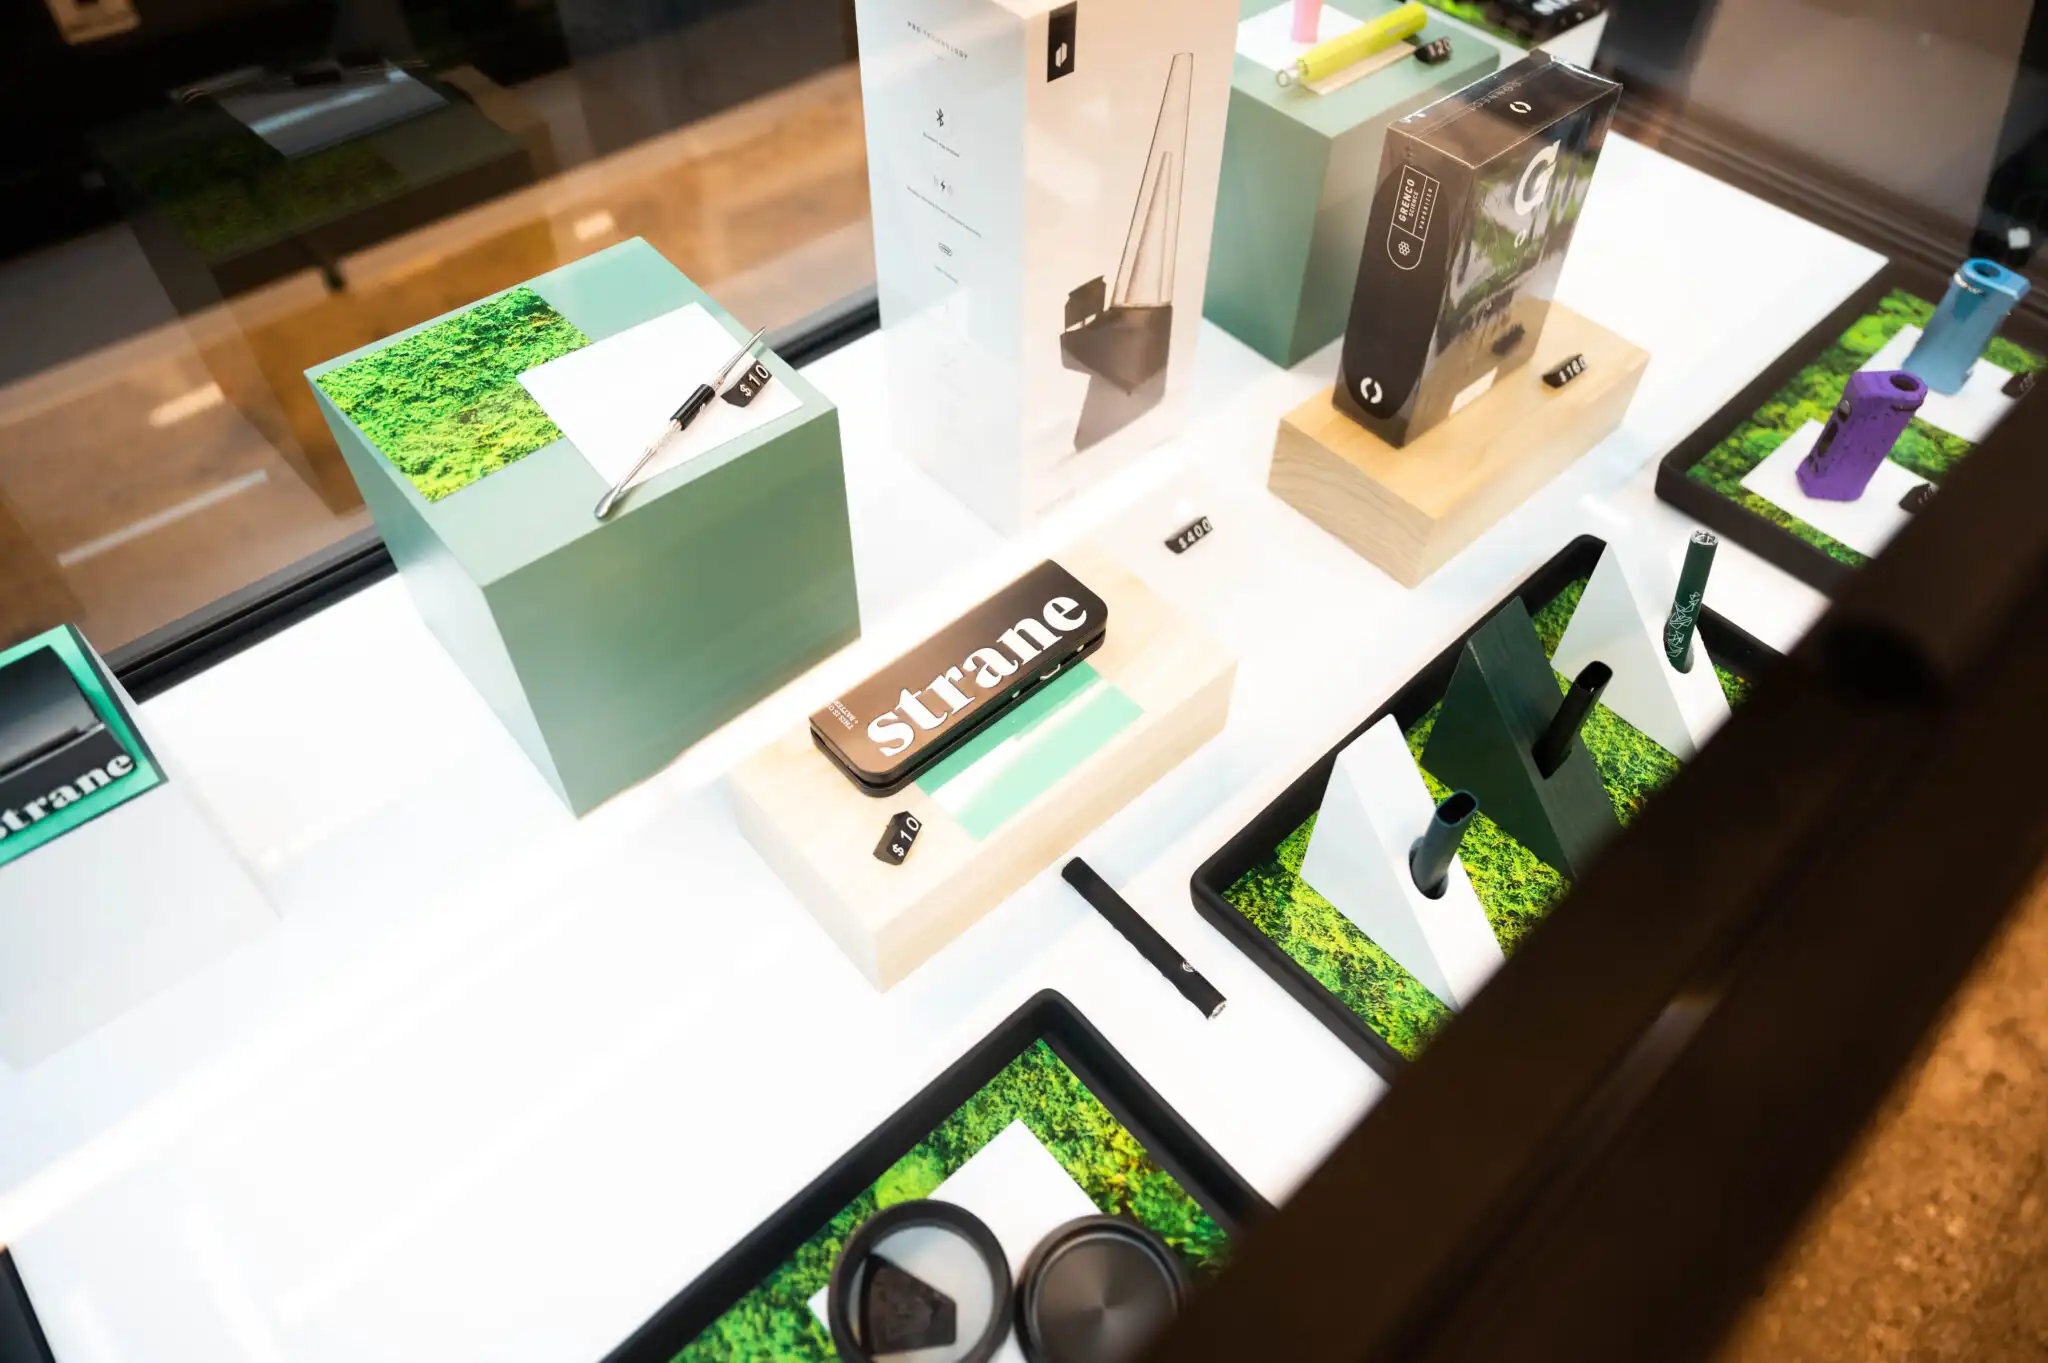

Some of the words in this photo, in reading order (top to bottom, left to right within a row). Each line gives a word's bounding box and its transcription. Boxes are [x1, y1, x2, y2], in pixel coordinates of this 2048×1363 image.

[1398, 178, 1416, 222] GRENCO
[1408, 191, 1419, 218] SCIENCE
[1418, 188, 1433, 230] VAPORIZER
[739, 364, 769, 397] $10
[1178, 518, 1211, 549] $400
[867, 596, 1087, 757] strane
[892, 816, 920, 857] $10
